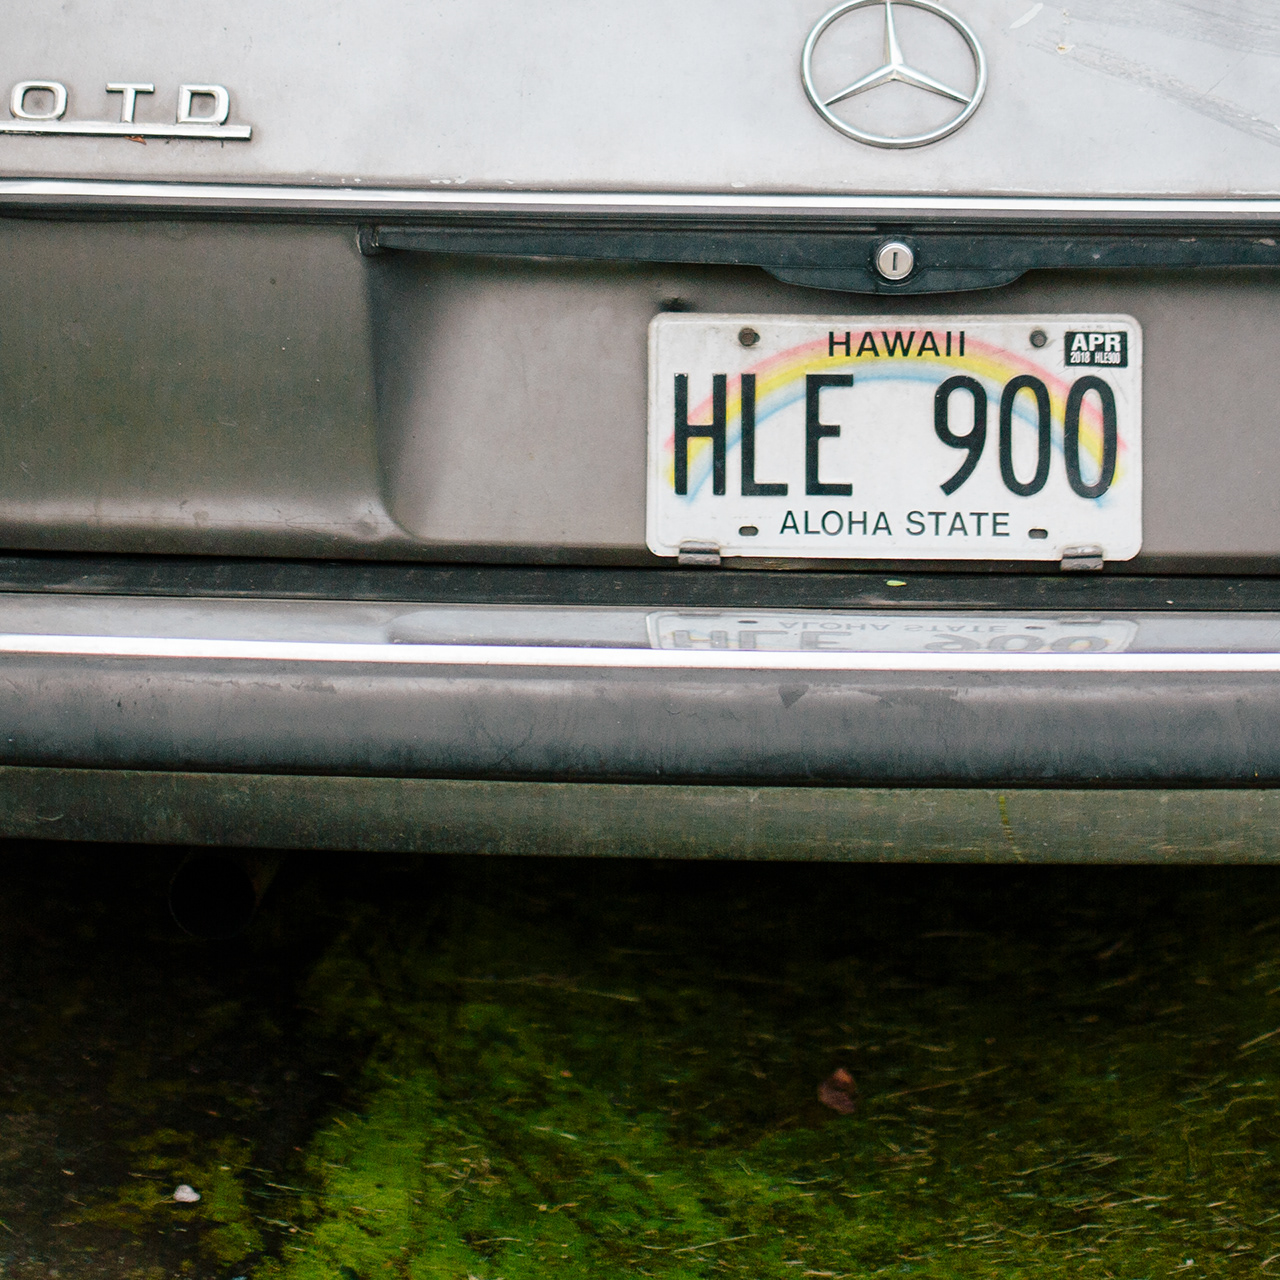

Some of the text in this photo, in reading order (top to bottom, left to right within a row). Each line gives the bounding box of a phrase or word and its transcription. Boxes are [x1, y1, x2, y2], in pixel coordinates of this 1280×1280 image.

[105, 82, 231, 125] TD
[827, 331, 966, 357] HAWAII
[1071, 333, 1121, 352] APR
[1070, 351, 1121, 365] 2018 HLE900
[673, 373, 1118, 499] HLE 900
[779, 510, 1011, 538] ALOHA STATE
